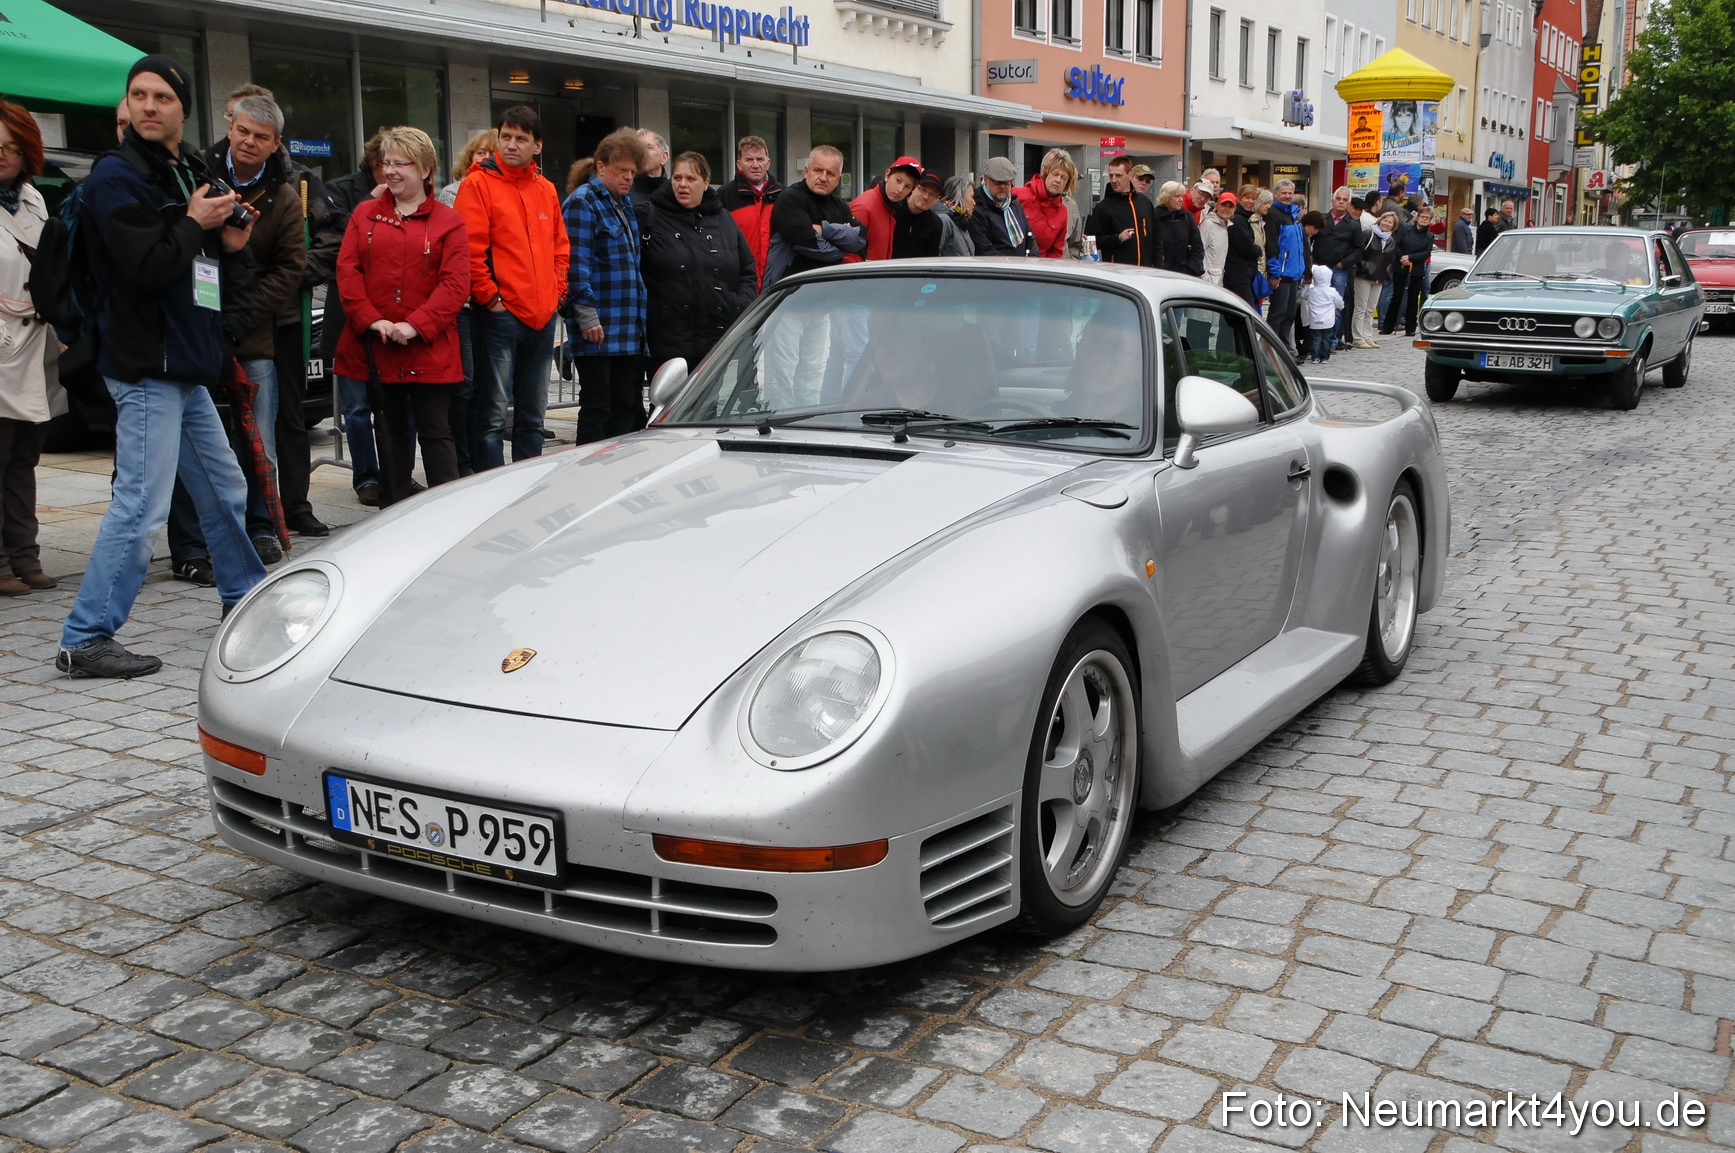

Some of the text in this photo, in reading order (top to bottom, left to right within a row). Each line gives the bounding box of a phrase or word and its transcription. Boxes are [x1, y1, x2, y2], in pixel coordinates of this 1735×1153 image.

[684, 0, 810, 46] Rupprecht
[1576, 46, 1600, 145] HOTEL
[299, 142, 330, 154] Rupprecht
[1508, 356, 1525, 368] AB
[1526, 357, 1552, 370] 32H
[350, 785, 551, 866] NES P 959
[387, 843, 492, 875] PORSCHE
